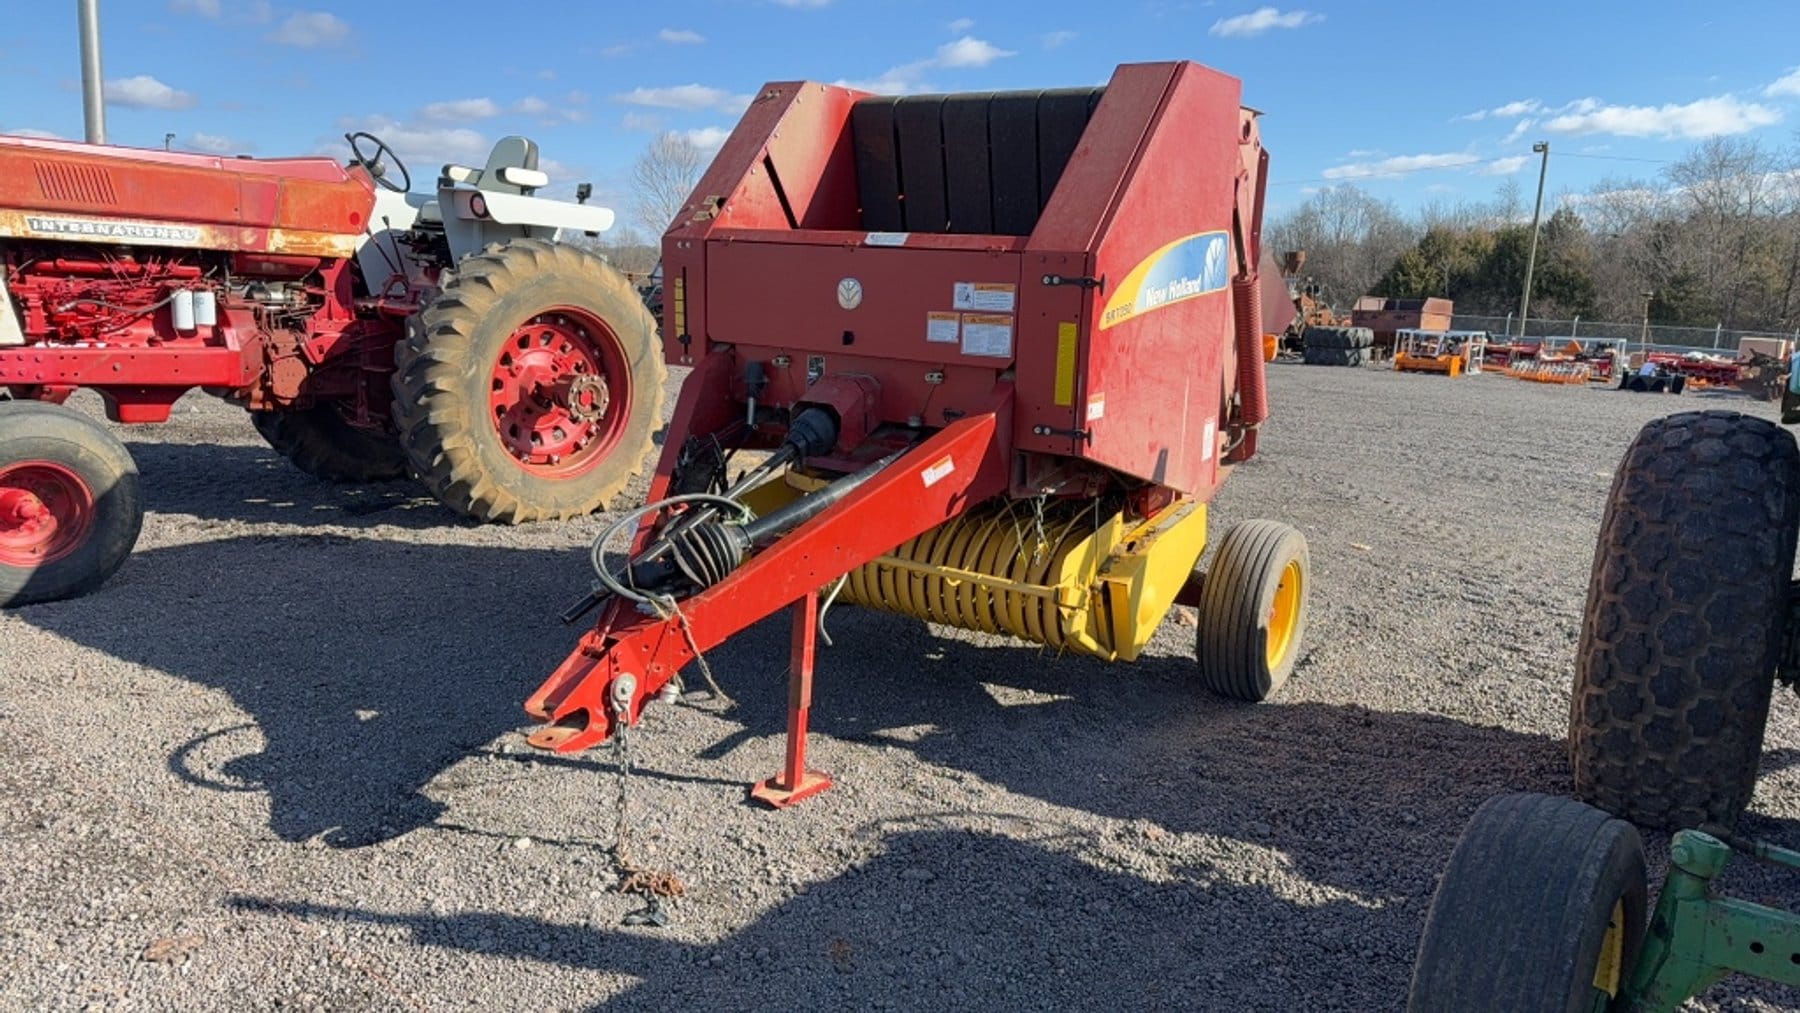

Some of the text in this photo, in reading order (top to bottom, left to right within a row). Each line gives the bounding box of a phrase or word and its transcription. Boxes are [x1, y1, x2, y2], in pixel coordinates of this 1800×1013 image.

[31, 219, 197, 240] INTERNATIONAL
[1145, 274, 1202, 308] New Holland
